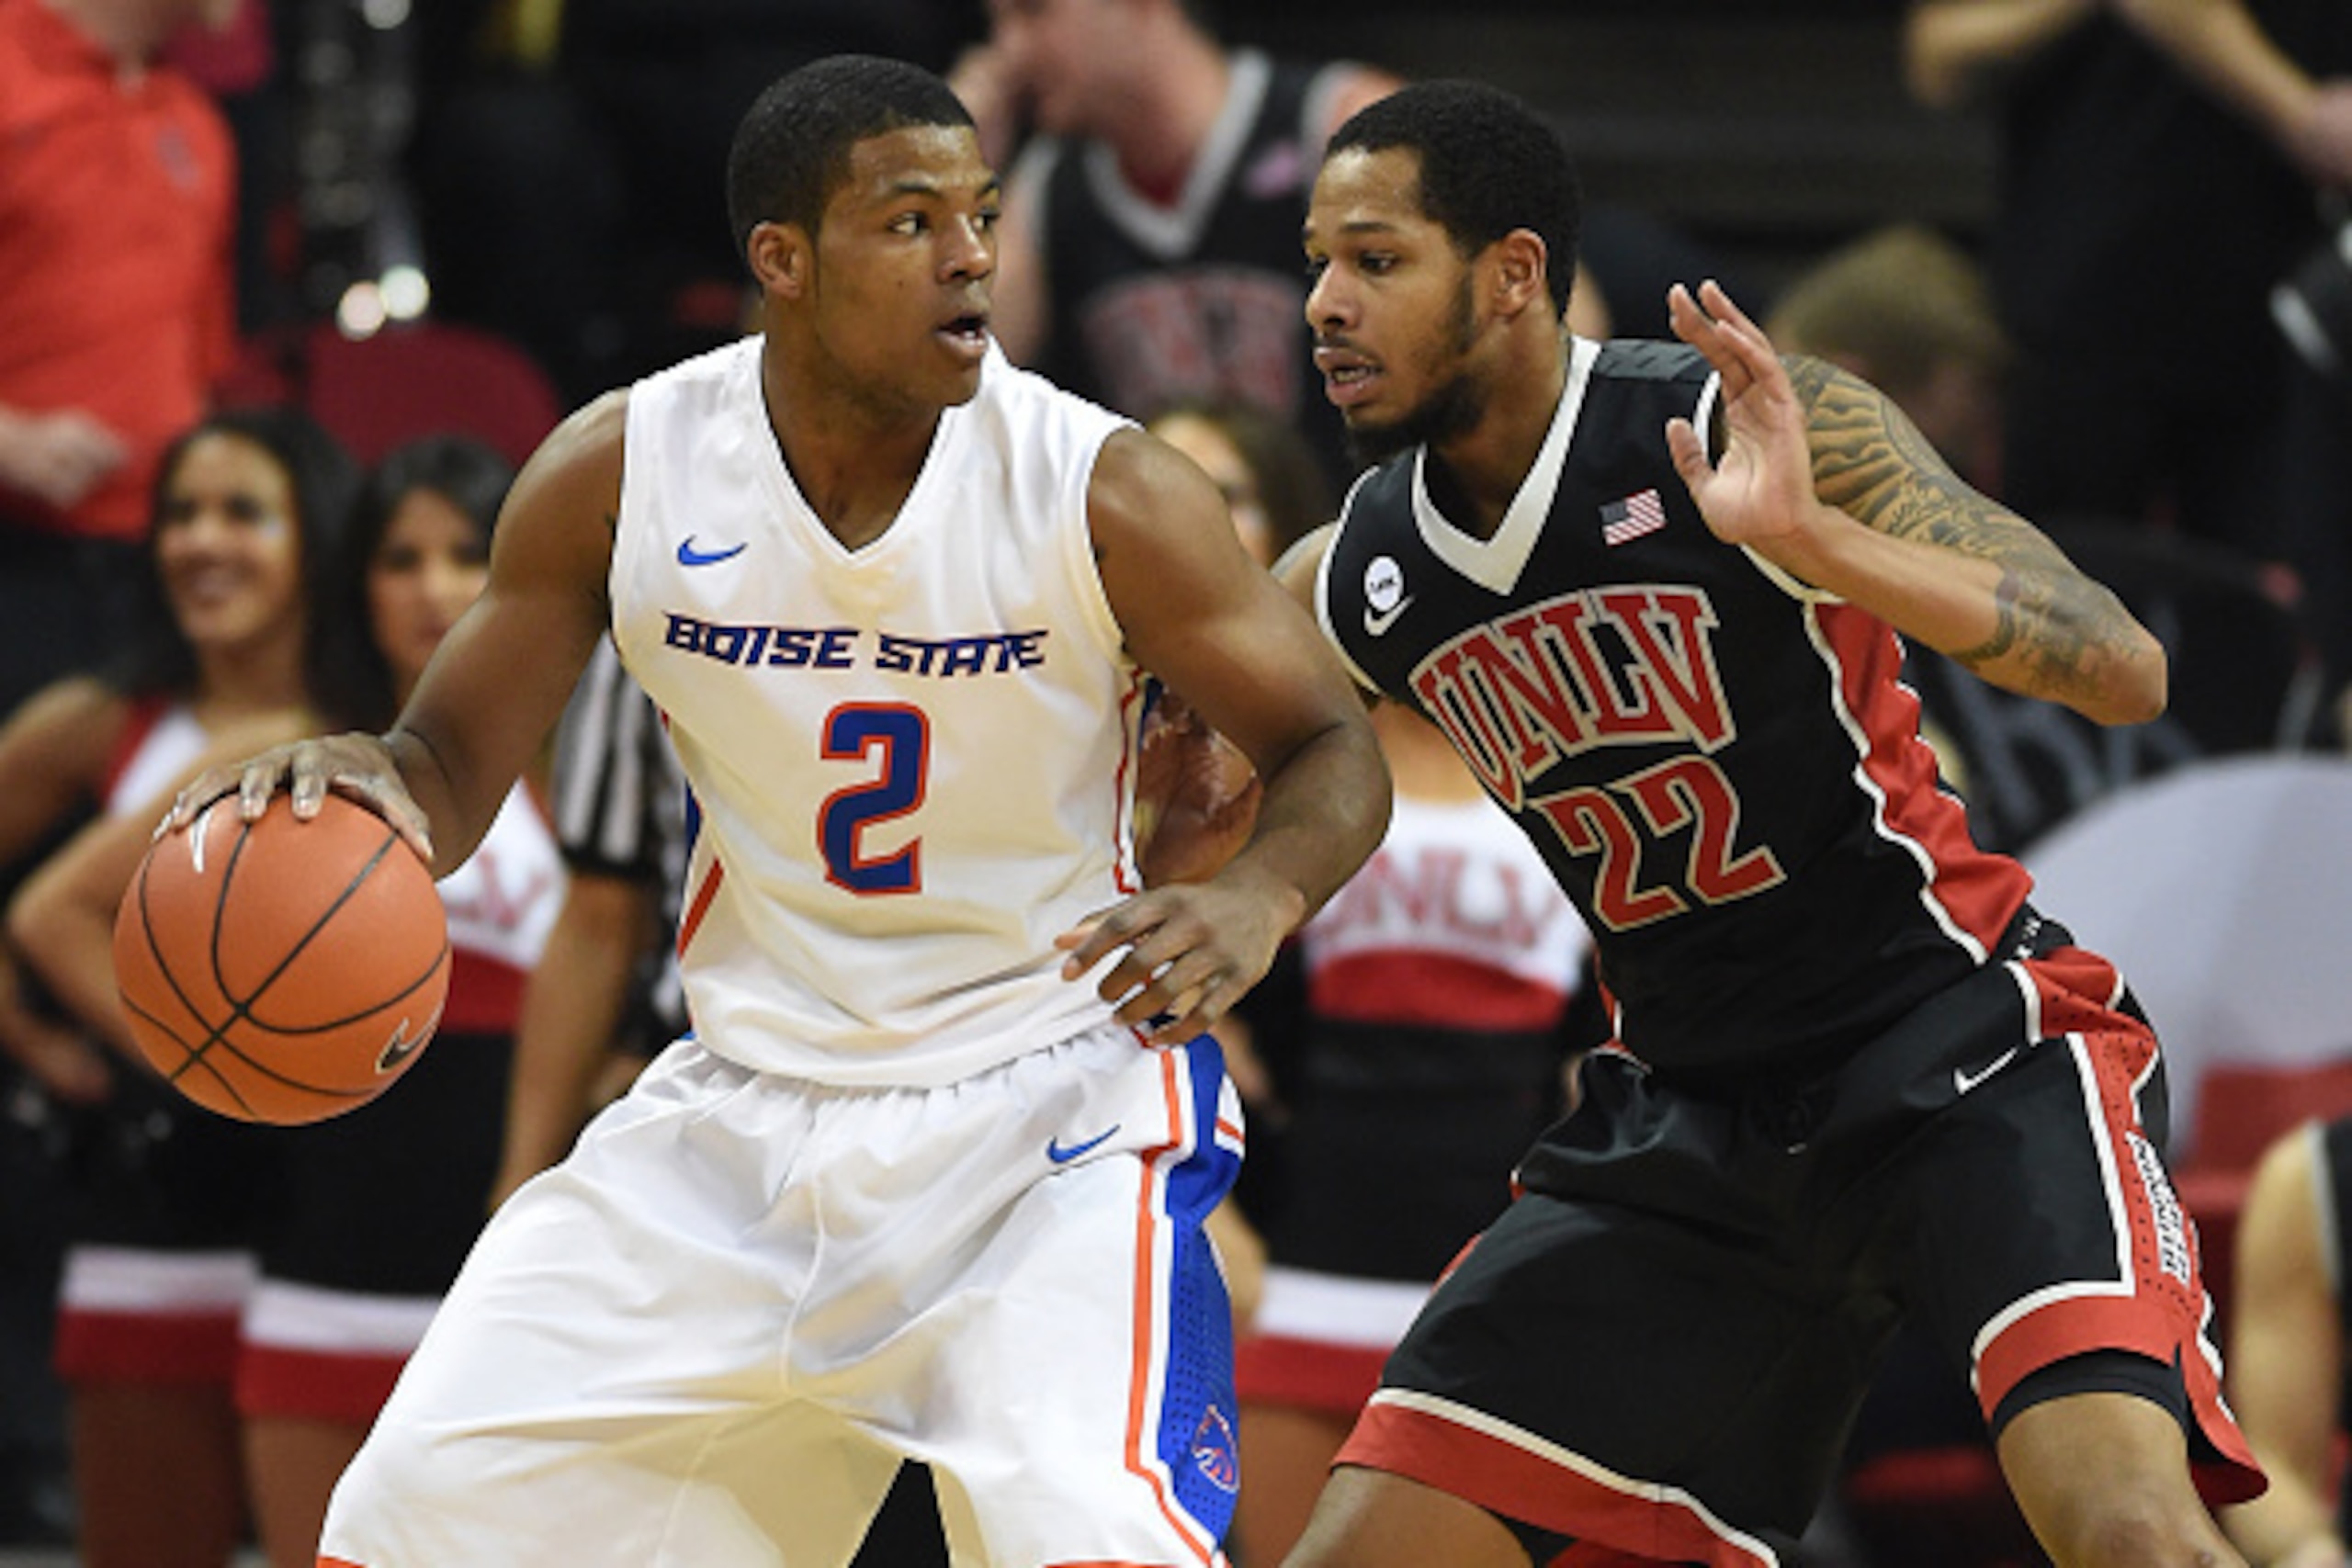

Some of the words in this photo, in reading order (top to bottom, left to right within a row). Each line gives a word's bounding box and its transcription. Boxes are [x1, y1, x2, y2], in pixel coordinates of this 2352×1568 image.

[662, 610, 861, 669] BOISE
[875, 630, 1048, 678] STATE
[1408, 583, 1737, 814] UNLV
[816, 701, 932, 898] 2
[1525, 753, 1789, 932] 22
